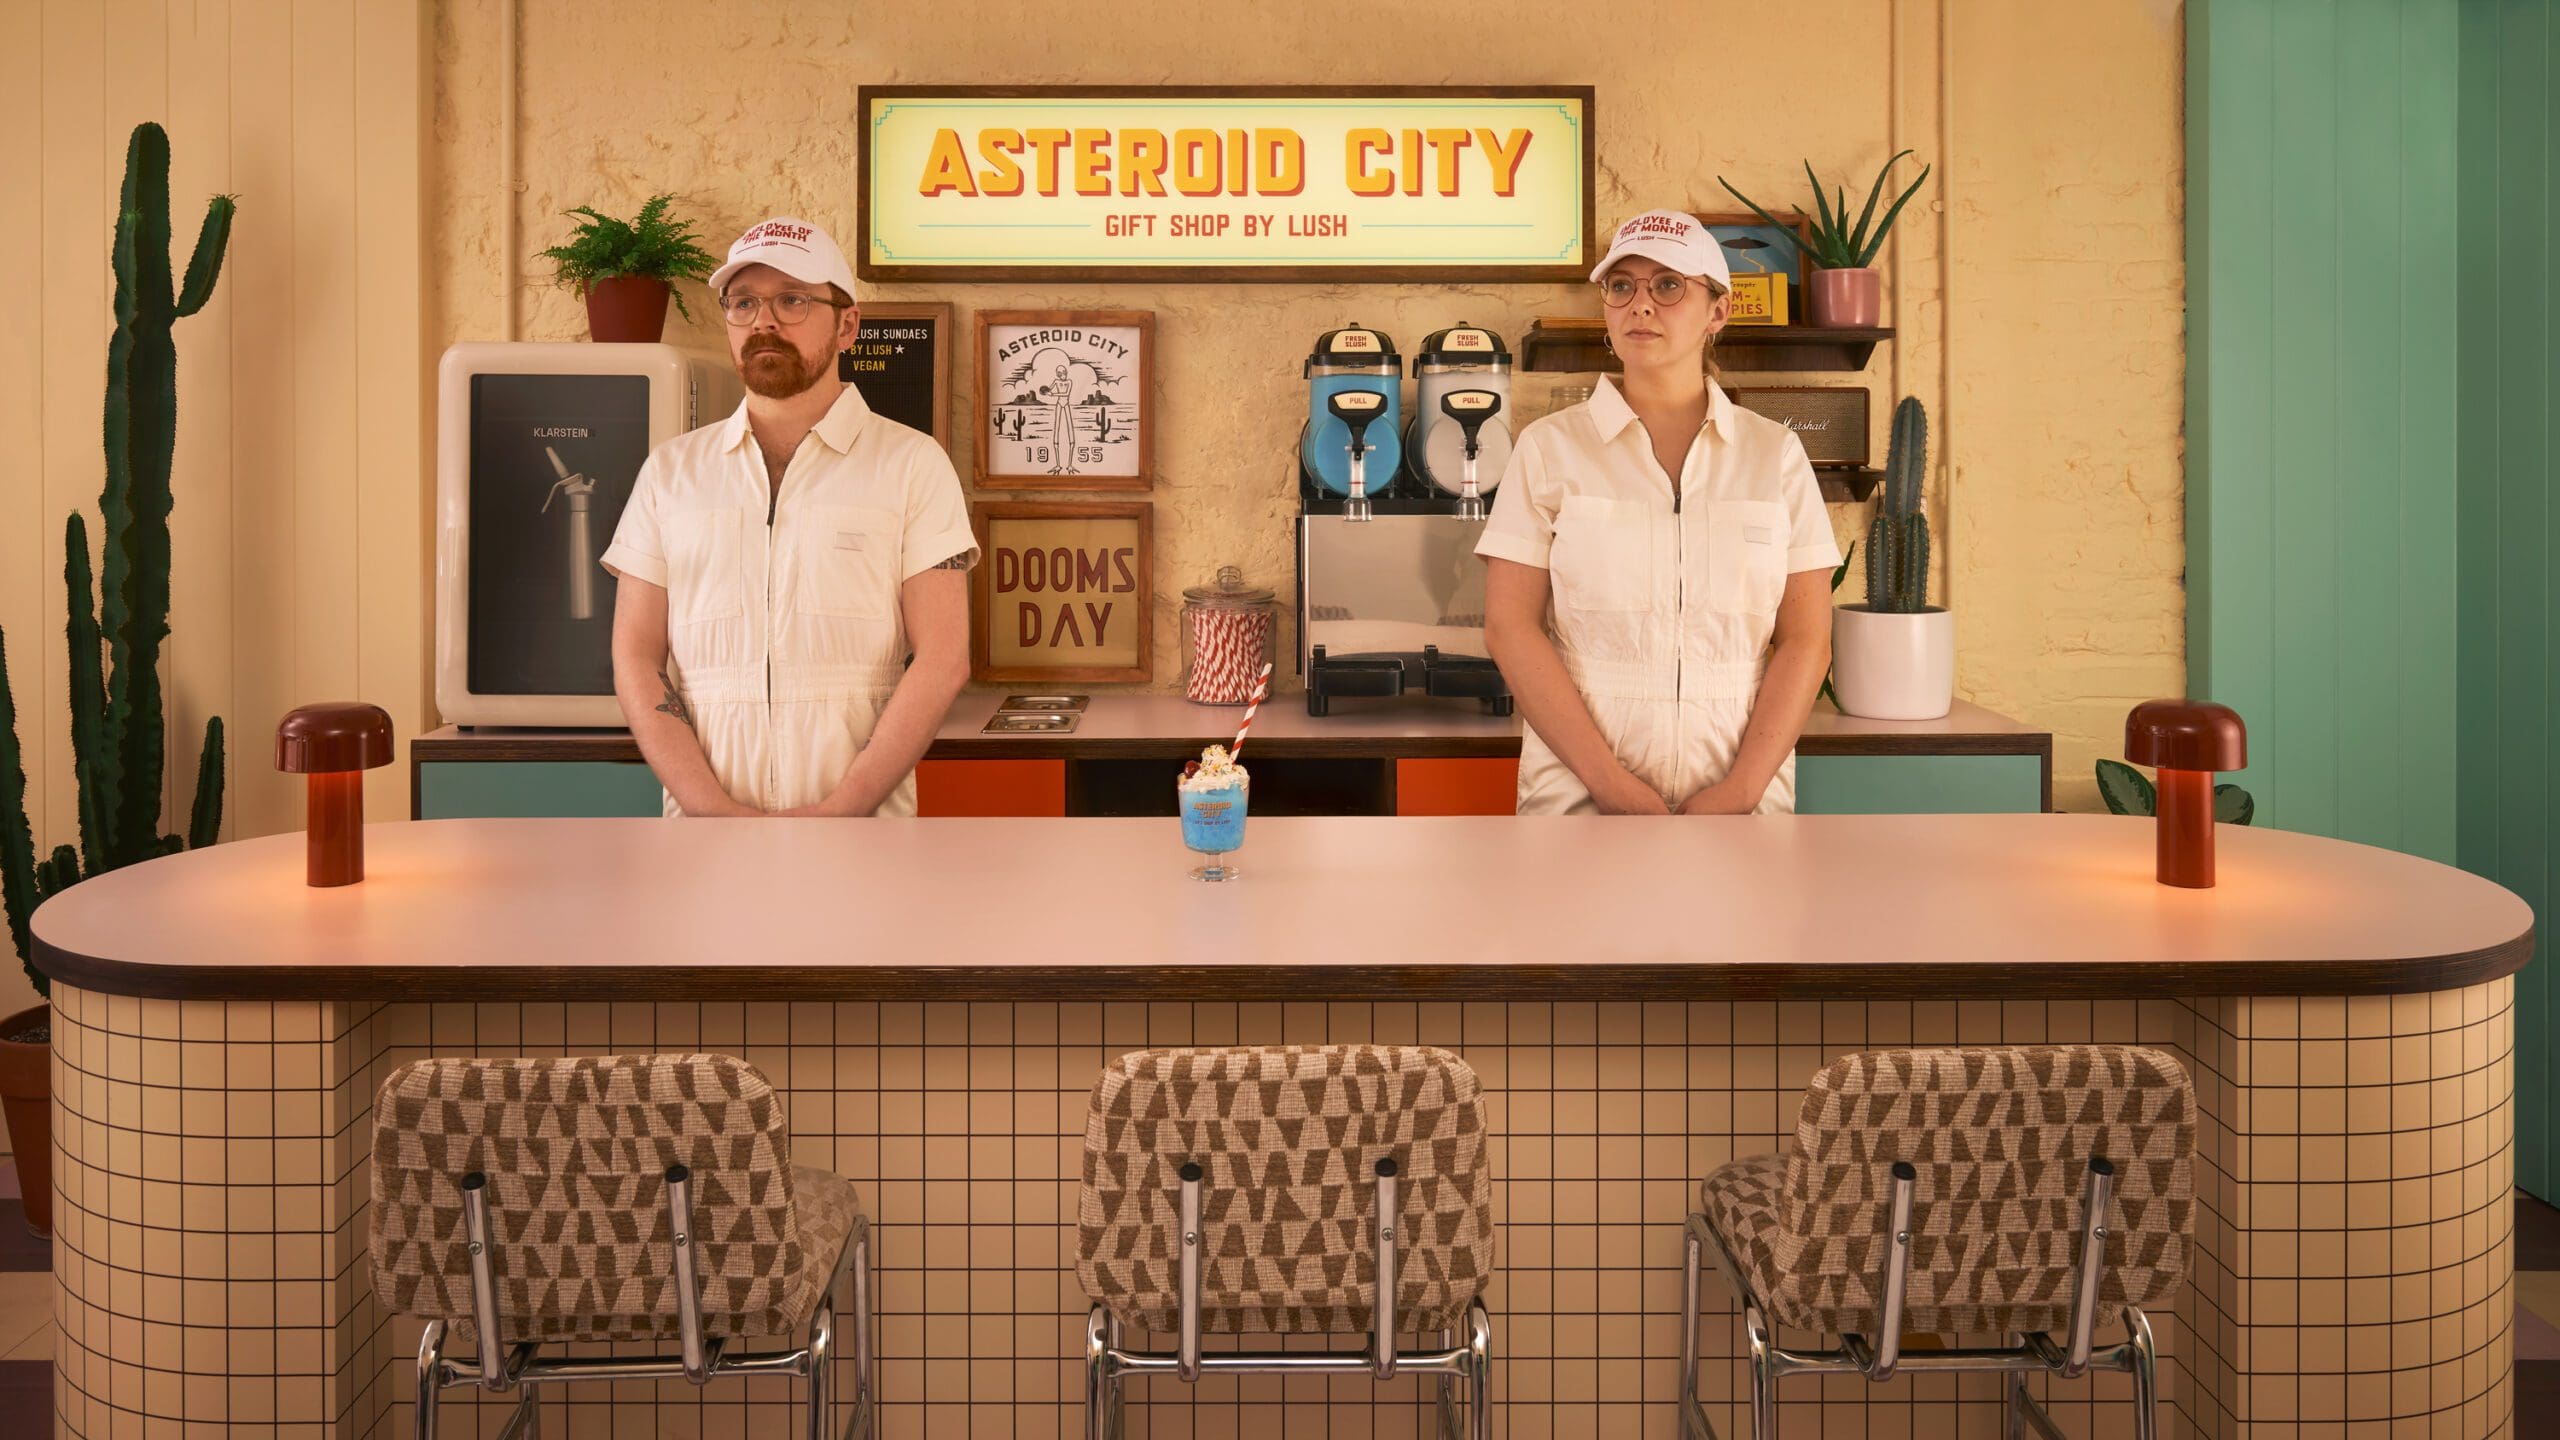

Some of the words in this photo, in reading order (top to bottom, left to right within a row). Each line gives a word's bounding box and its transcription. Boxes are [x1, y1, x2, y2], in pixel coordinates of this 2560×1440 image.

[918, 128, 1306, 198] ASTEROID
[1344, 128, 1534, 198] CITY
[798, 226, 814, 236] OF
[1105, 214, 1157, 237] GIFT
[1170, 214, 1230, 237] SHOP
[1243, 214, 1275, 237] BY
[1288, 214, 1348, 237] LUSH
[1619, 215, 1673, 236] EMPLOYEE
[1675, 221, 1692, 232] OF
[1620, 225, 1638, 240] THE
[1640, 223, 1685, 237] MONTH
[744, 232, 761, 245] THE
[764, 229, 808, 243] MONTH
[882, 328, 928, 340] SUNDAES
[850, 344, 863, 356] BY
[866, 344, 892, 356] LUSH
[998, 329, 1082, 362] ASTEROID
[1088, 334, 1129, 359] CITY
[853, 360, 886, 372] VEGAN
[1783, 416, 1830, 430] Marshall
[533, 427, 588, 438] KLARSTEIN
[996, 547, 1136, 593] DOOMS
[1019, 601, 1113, 648] DAY
